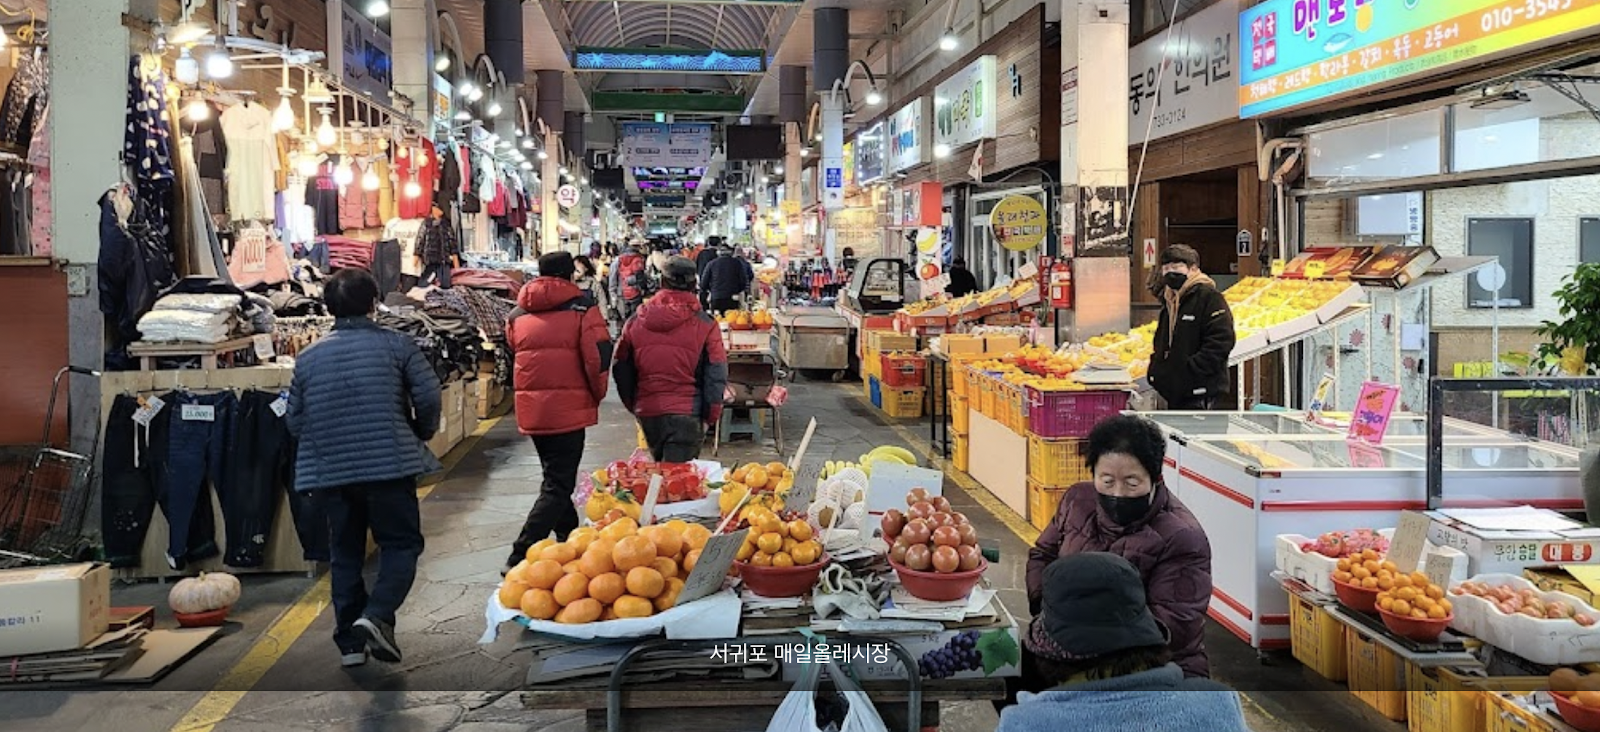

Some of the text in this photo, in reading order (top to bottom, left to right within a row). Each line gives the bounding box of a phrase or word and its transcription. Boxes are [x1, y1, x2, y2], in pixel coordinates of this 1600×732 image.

[1319, 54, 1350, 79] 한라봉
[1423, 23, 1459, 48] 고등어
[1130, 62, 1162, 115] 동의
[560, 188, 576, 204] 약
